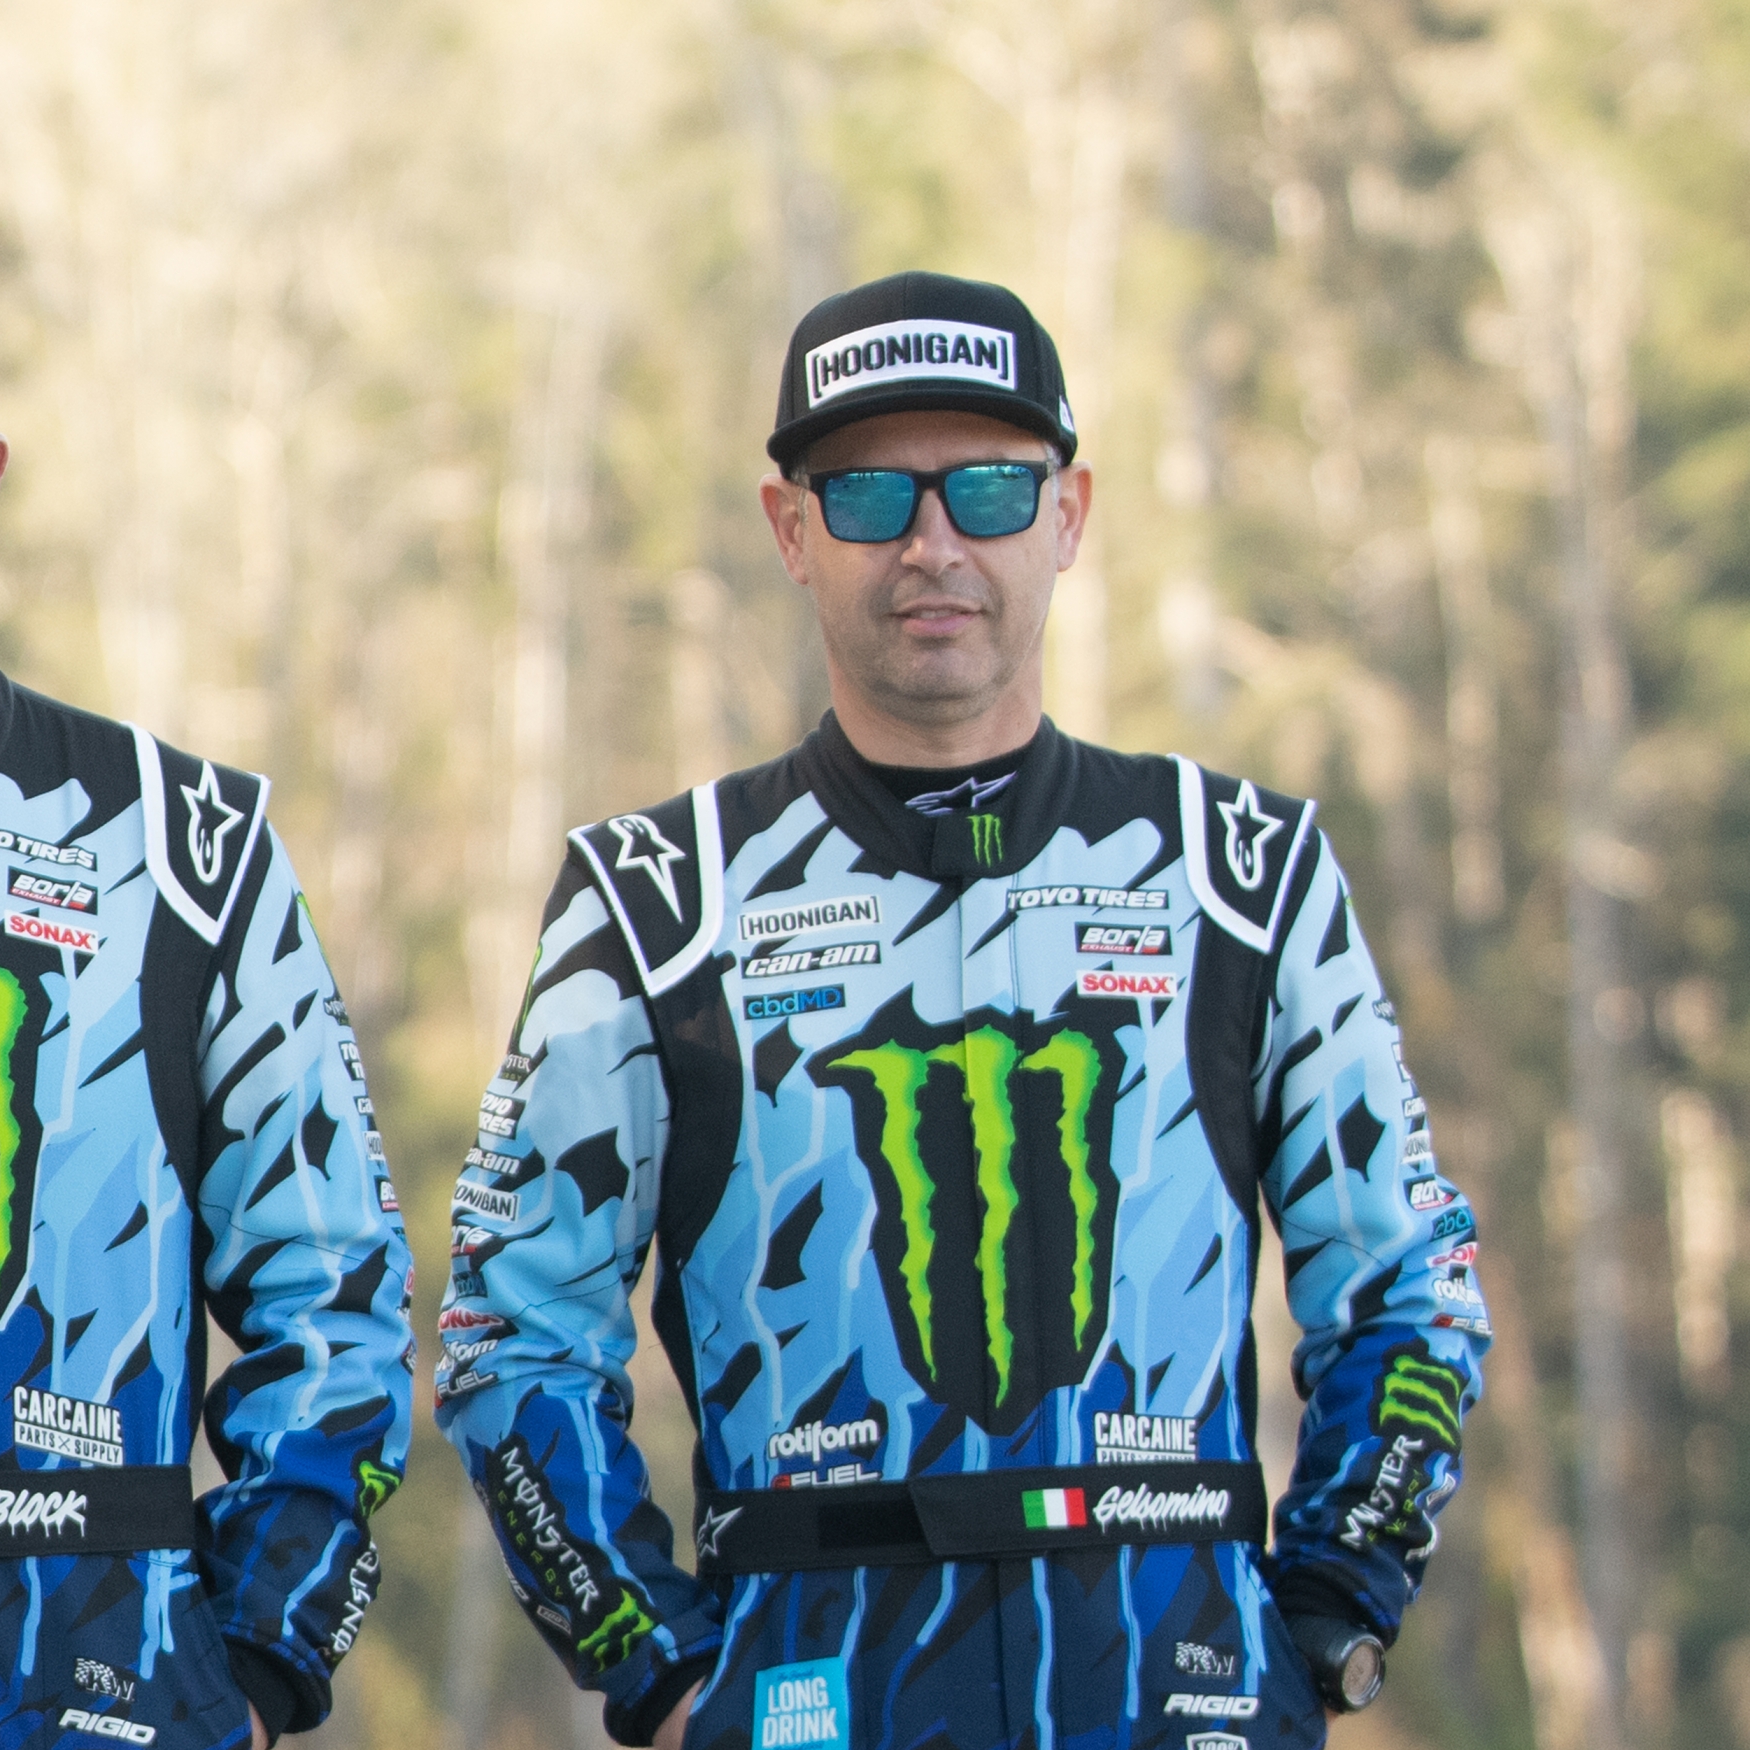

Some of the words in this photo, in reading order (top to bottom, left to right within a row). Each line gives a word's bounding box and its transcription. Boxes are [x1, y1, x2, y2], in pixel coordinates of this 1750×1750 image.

[17, 836, 95, 869] TIRES
[1008, 887, 1079, 909] TOYO
[1082, 889, 1166, 907] TIRES
[10, 915, 93, 949] SONAX
[745, 943, 878, 977] can-am
[1083, 974, 1170, 993] SONAX
[747, 988, 841, 1017] cbdMD
[14, 1386, 122, 1444] CARCAINE
[1094, 1412, 1196, 1450] CARCAINE
[19, 1425, 55, 1448] PARTS
[74, 1439, 120, 1463] SUPPLY
[768, 1418, 878, 1462] rotiform
[1093, 1483, 1230, 1534] Gelsomino
[768, 1676, 829, 1714] LONG
[1163, 1693, 1259, 1716] RIGID
[58, 1708, 156, 1744] RIGID
[762, 1707, 839, 1748] DRINK
